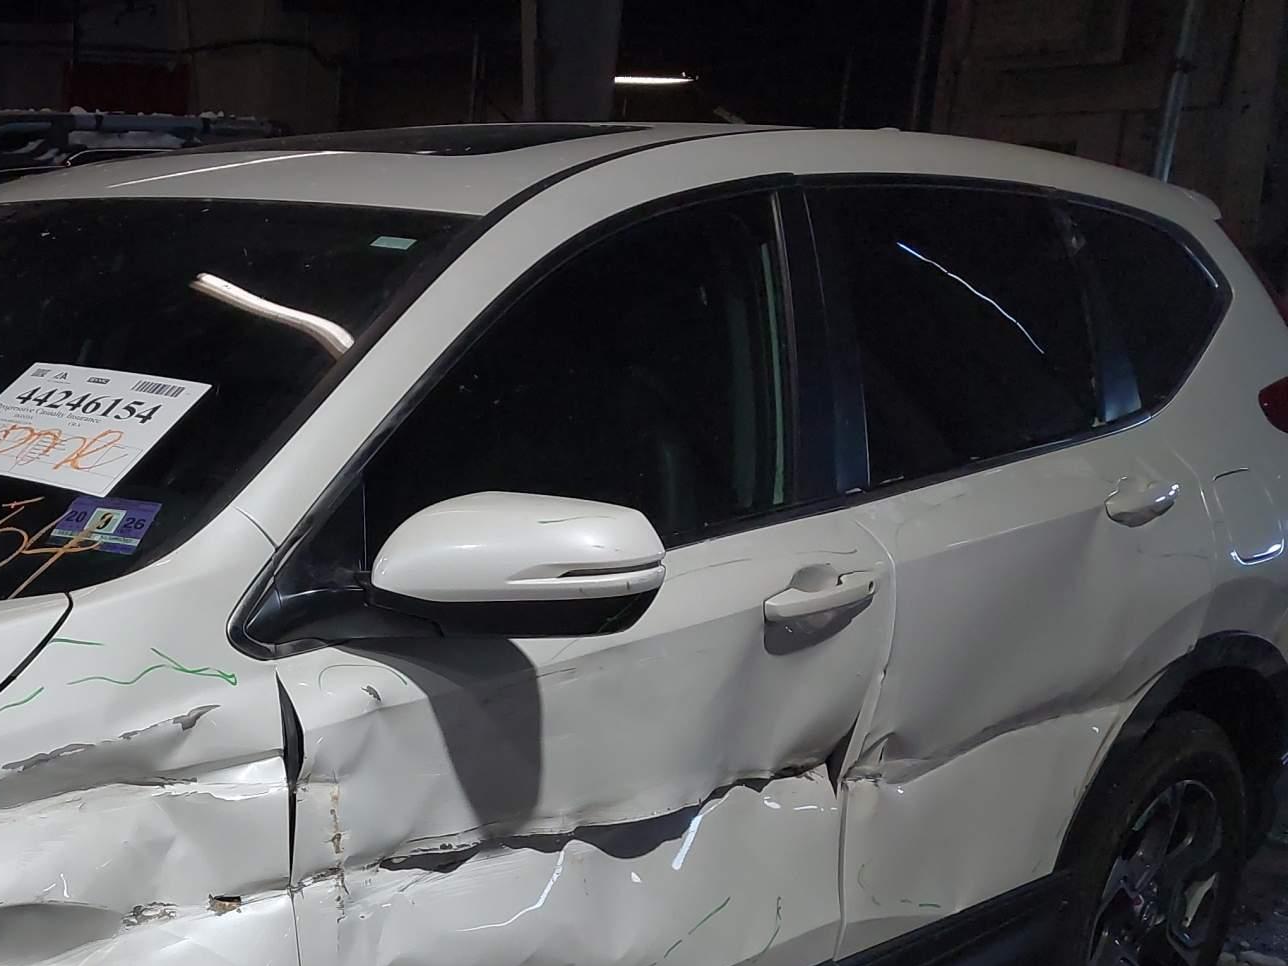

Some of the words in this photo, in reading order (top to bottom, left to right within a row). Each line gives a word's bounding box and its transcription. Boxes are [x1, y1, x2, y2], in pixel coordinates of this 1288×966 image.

[15, 386, 162, 424] 44246154
[65, 510, 88, 523] 20
[123, 517, 146, 530] 26
